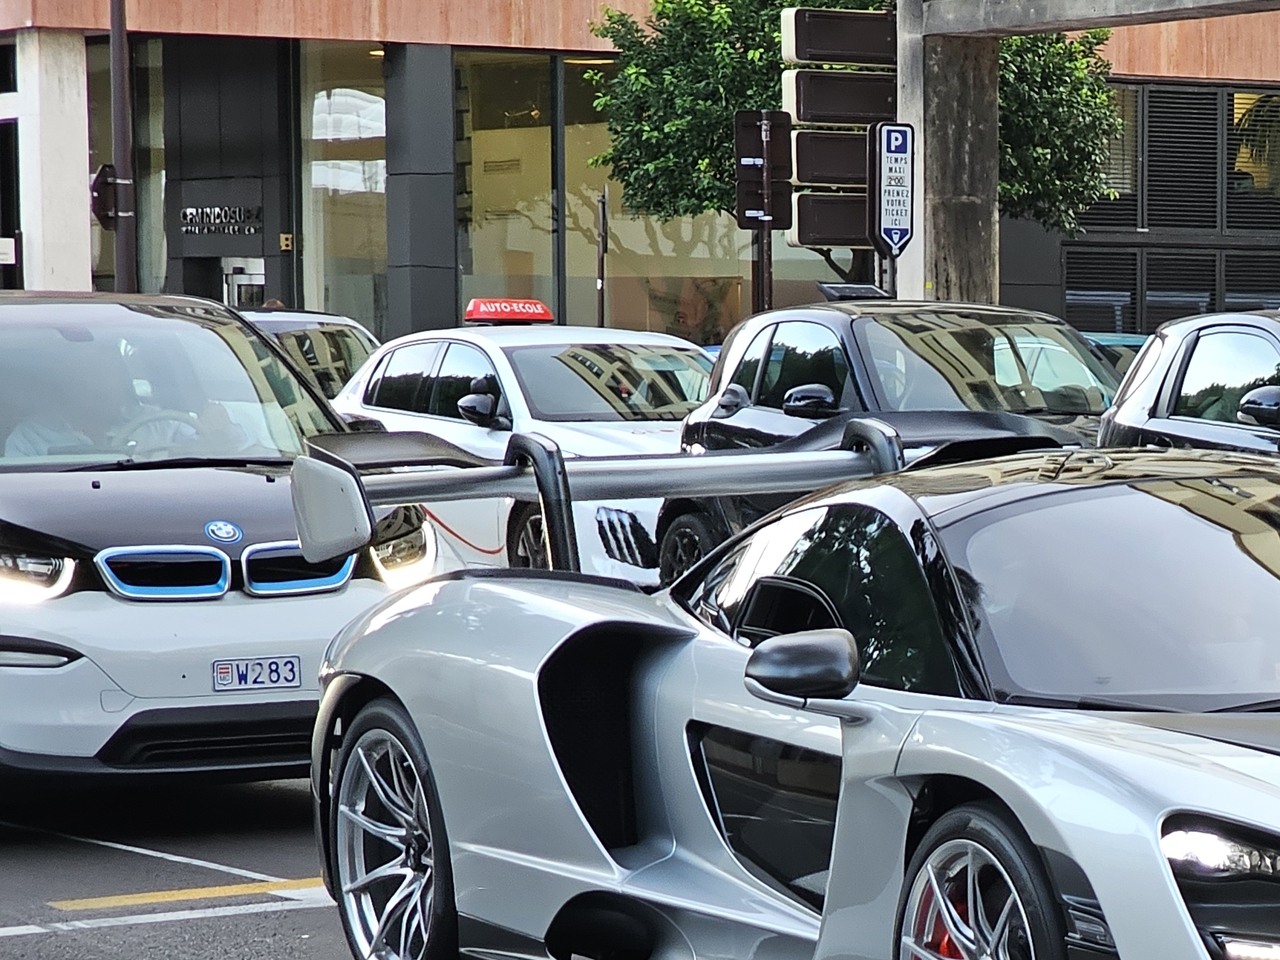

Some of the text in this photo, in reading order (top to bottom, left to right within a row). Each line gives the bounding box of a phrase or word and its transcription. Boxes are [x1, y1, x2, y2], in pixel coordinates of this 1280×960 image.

[891, 132, 902, 150] P
[886, 156, 908, 165] TEMPS
[888, 166, 905, 174] MAXI
[883, 189, 910, 198] PRENEZ
[886, 199, 907, 207] VOTRE
[884, 208, 909, 217] TICKET
[890, 218, 901, 226] ICI
[480, 302, 545, 314] AUTO-ECOLE
[236, 660, 295, 685] W283
